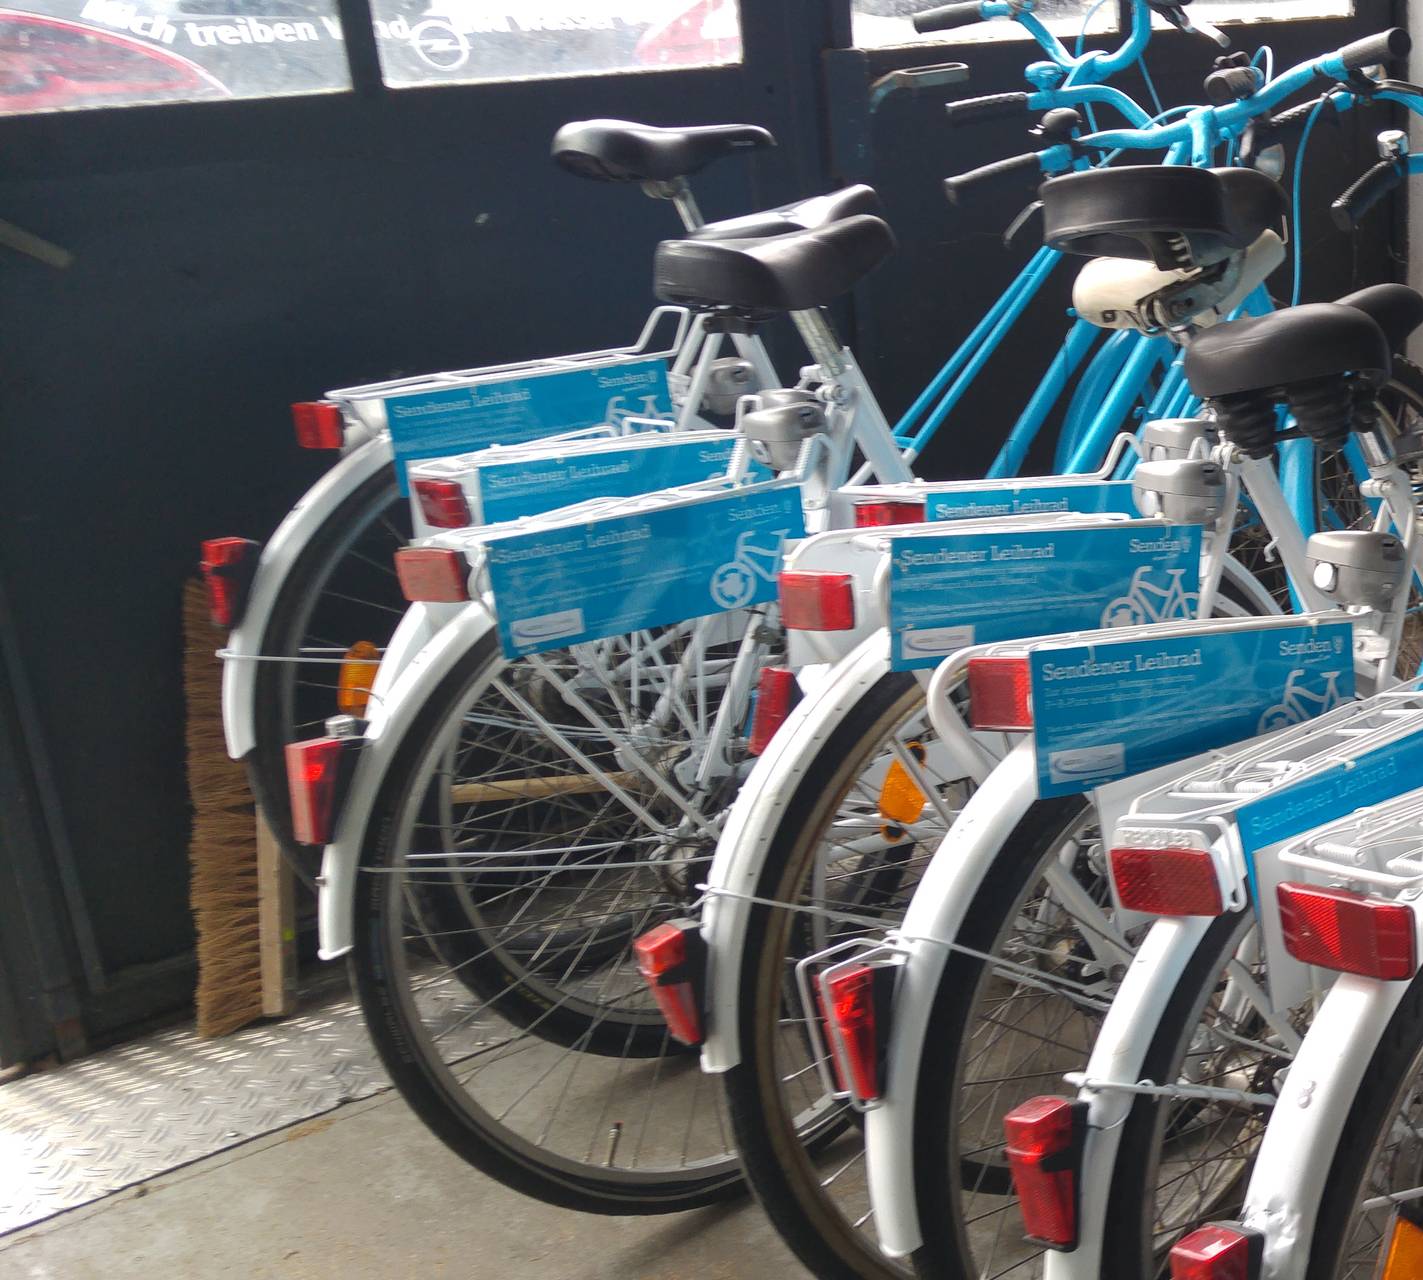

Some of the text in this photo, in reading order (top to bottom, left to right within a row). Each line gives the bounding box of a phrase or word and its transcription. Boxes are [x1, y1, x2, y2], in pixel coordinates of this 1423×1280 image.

[186, 17, 319, 46] treiben
[935, 498, 1068, 518] Sendener Leihrad
[901, 543, 1055, 566] Sendener Leihrad
[1129, 538, 1181, 552] Senden
[1280, 639, 1332, 656] Senden
[1042, 649, 1202, 681] Sendener Leihrad
[1251, 757, 1398, 836] Sendener Leihrad
